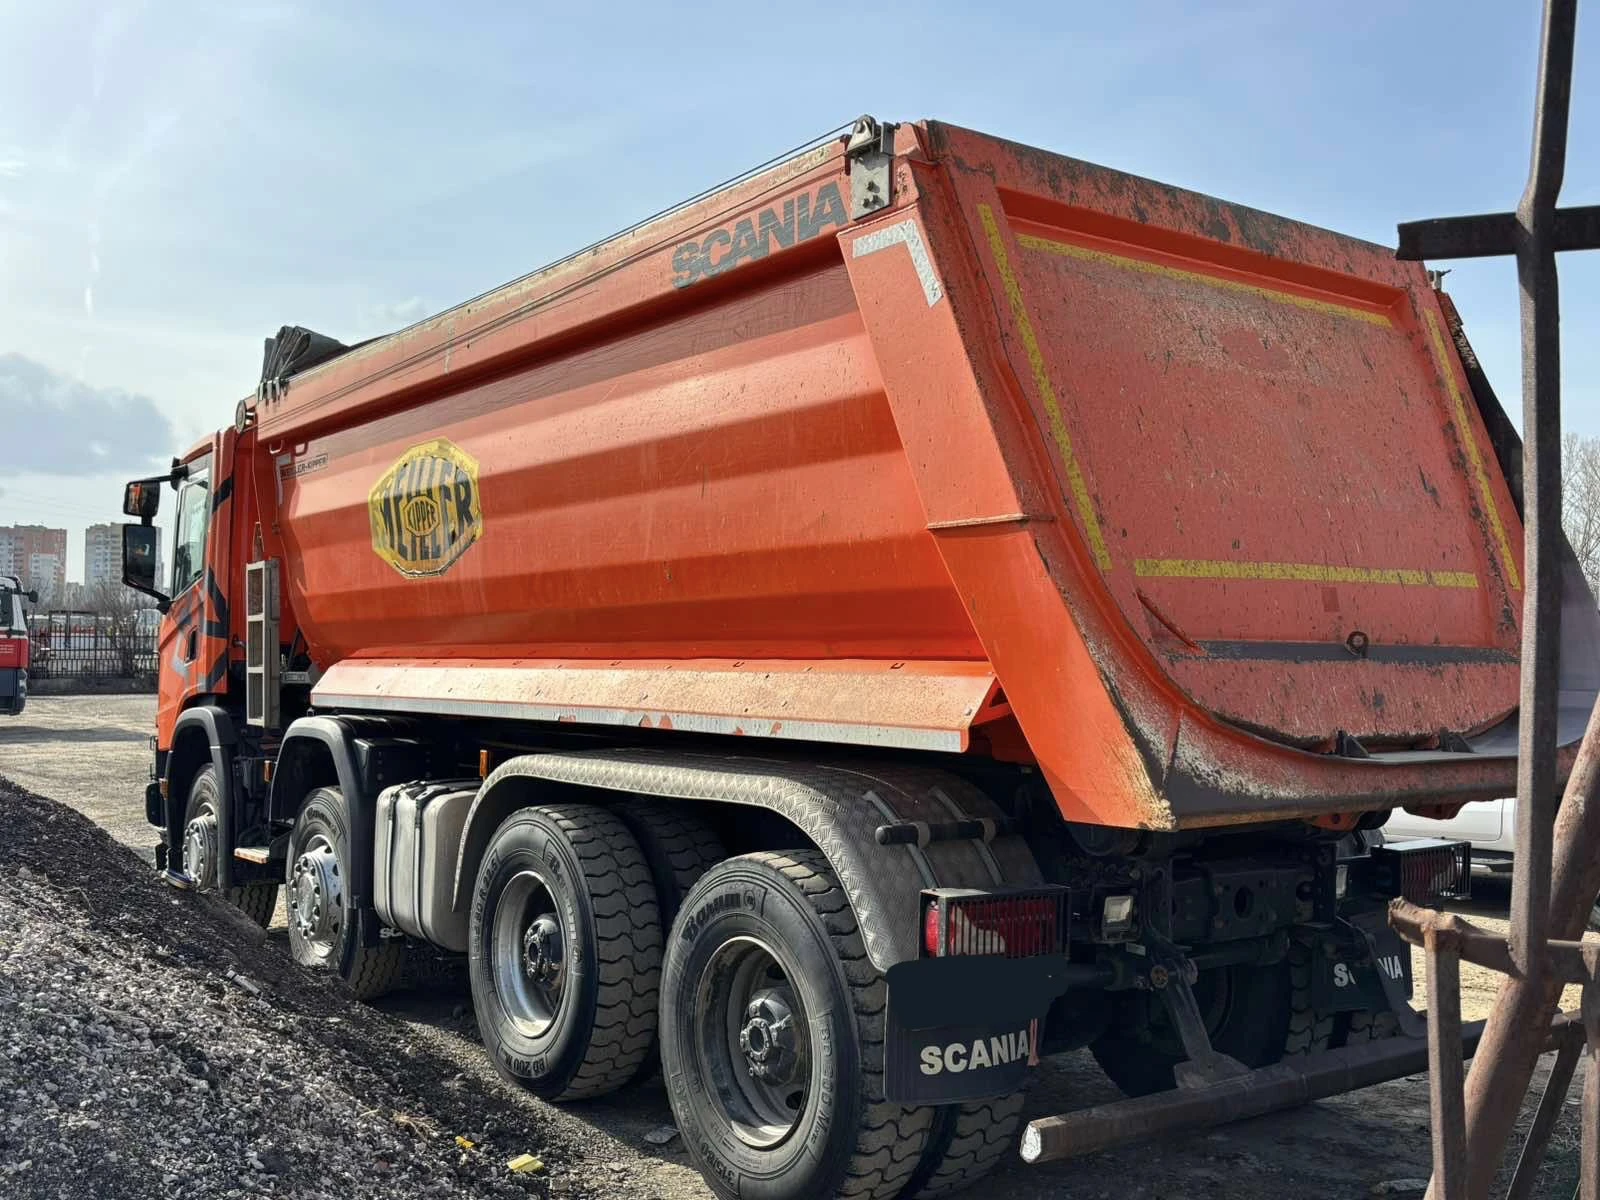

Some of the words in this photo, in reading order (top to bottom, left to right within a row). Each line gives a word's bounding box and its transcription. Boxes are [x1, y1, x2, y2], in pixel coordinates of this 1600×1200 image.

[672, 181, 849, 289] SCANIA
[408, 500, 438, 532] KIPPER
[919, 1029, 1030, 1075] SCANIA
